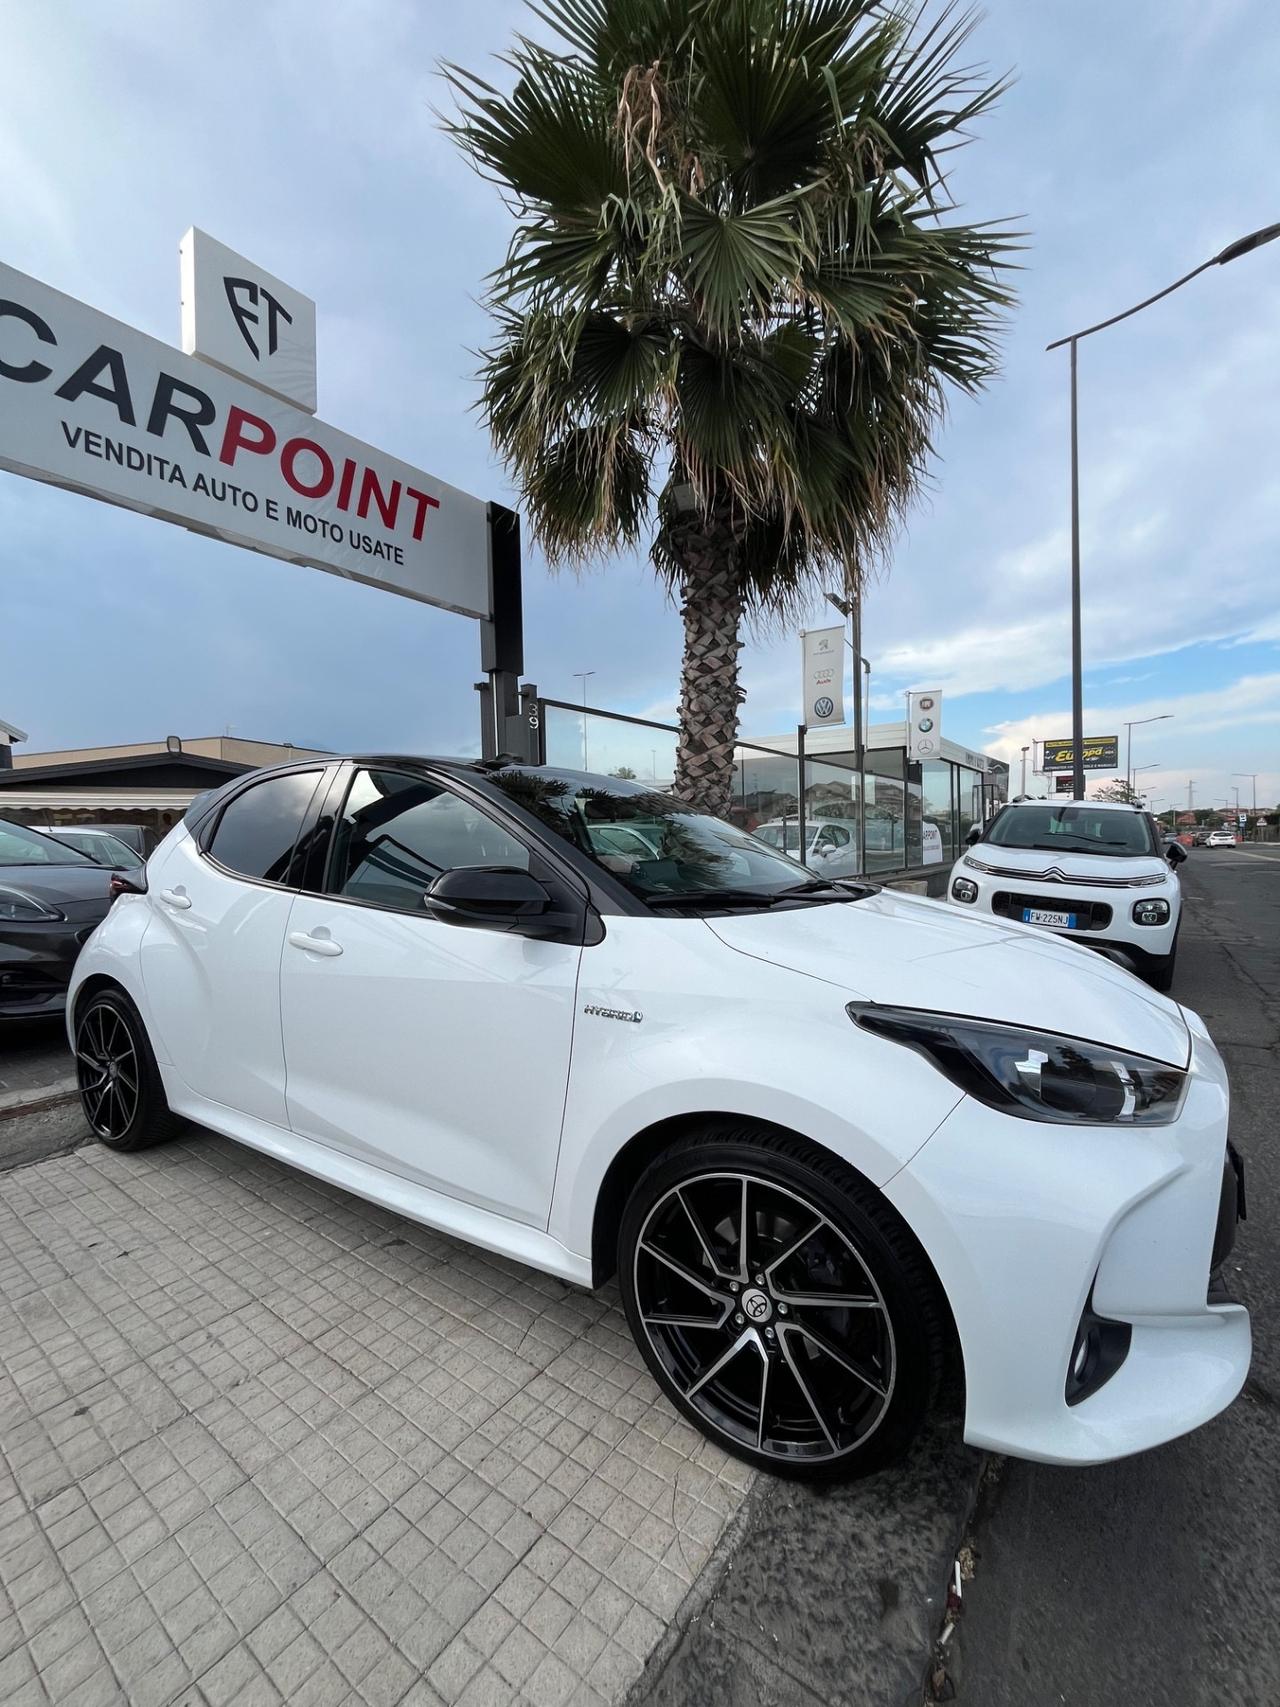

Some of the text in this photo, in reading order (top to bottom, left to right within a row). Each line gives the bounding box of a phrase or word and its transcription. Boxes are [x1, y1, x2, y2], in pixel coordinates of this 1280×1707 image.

[61, 421, 405, 565] VENDITA AUTO E MOTO USATE
